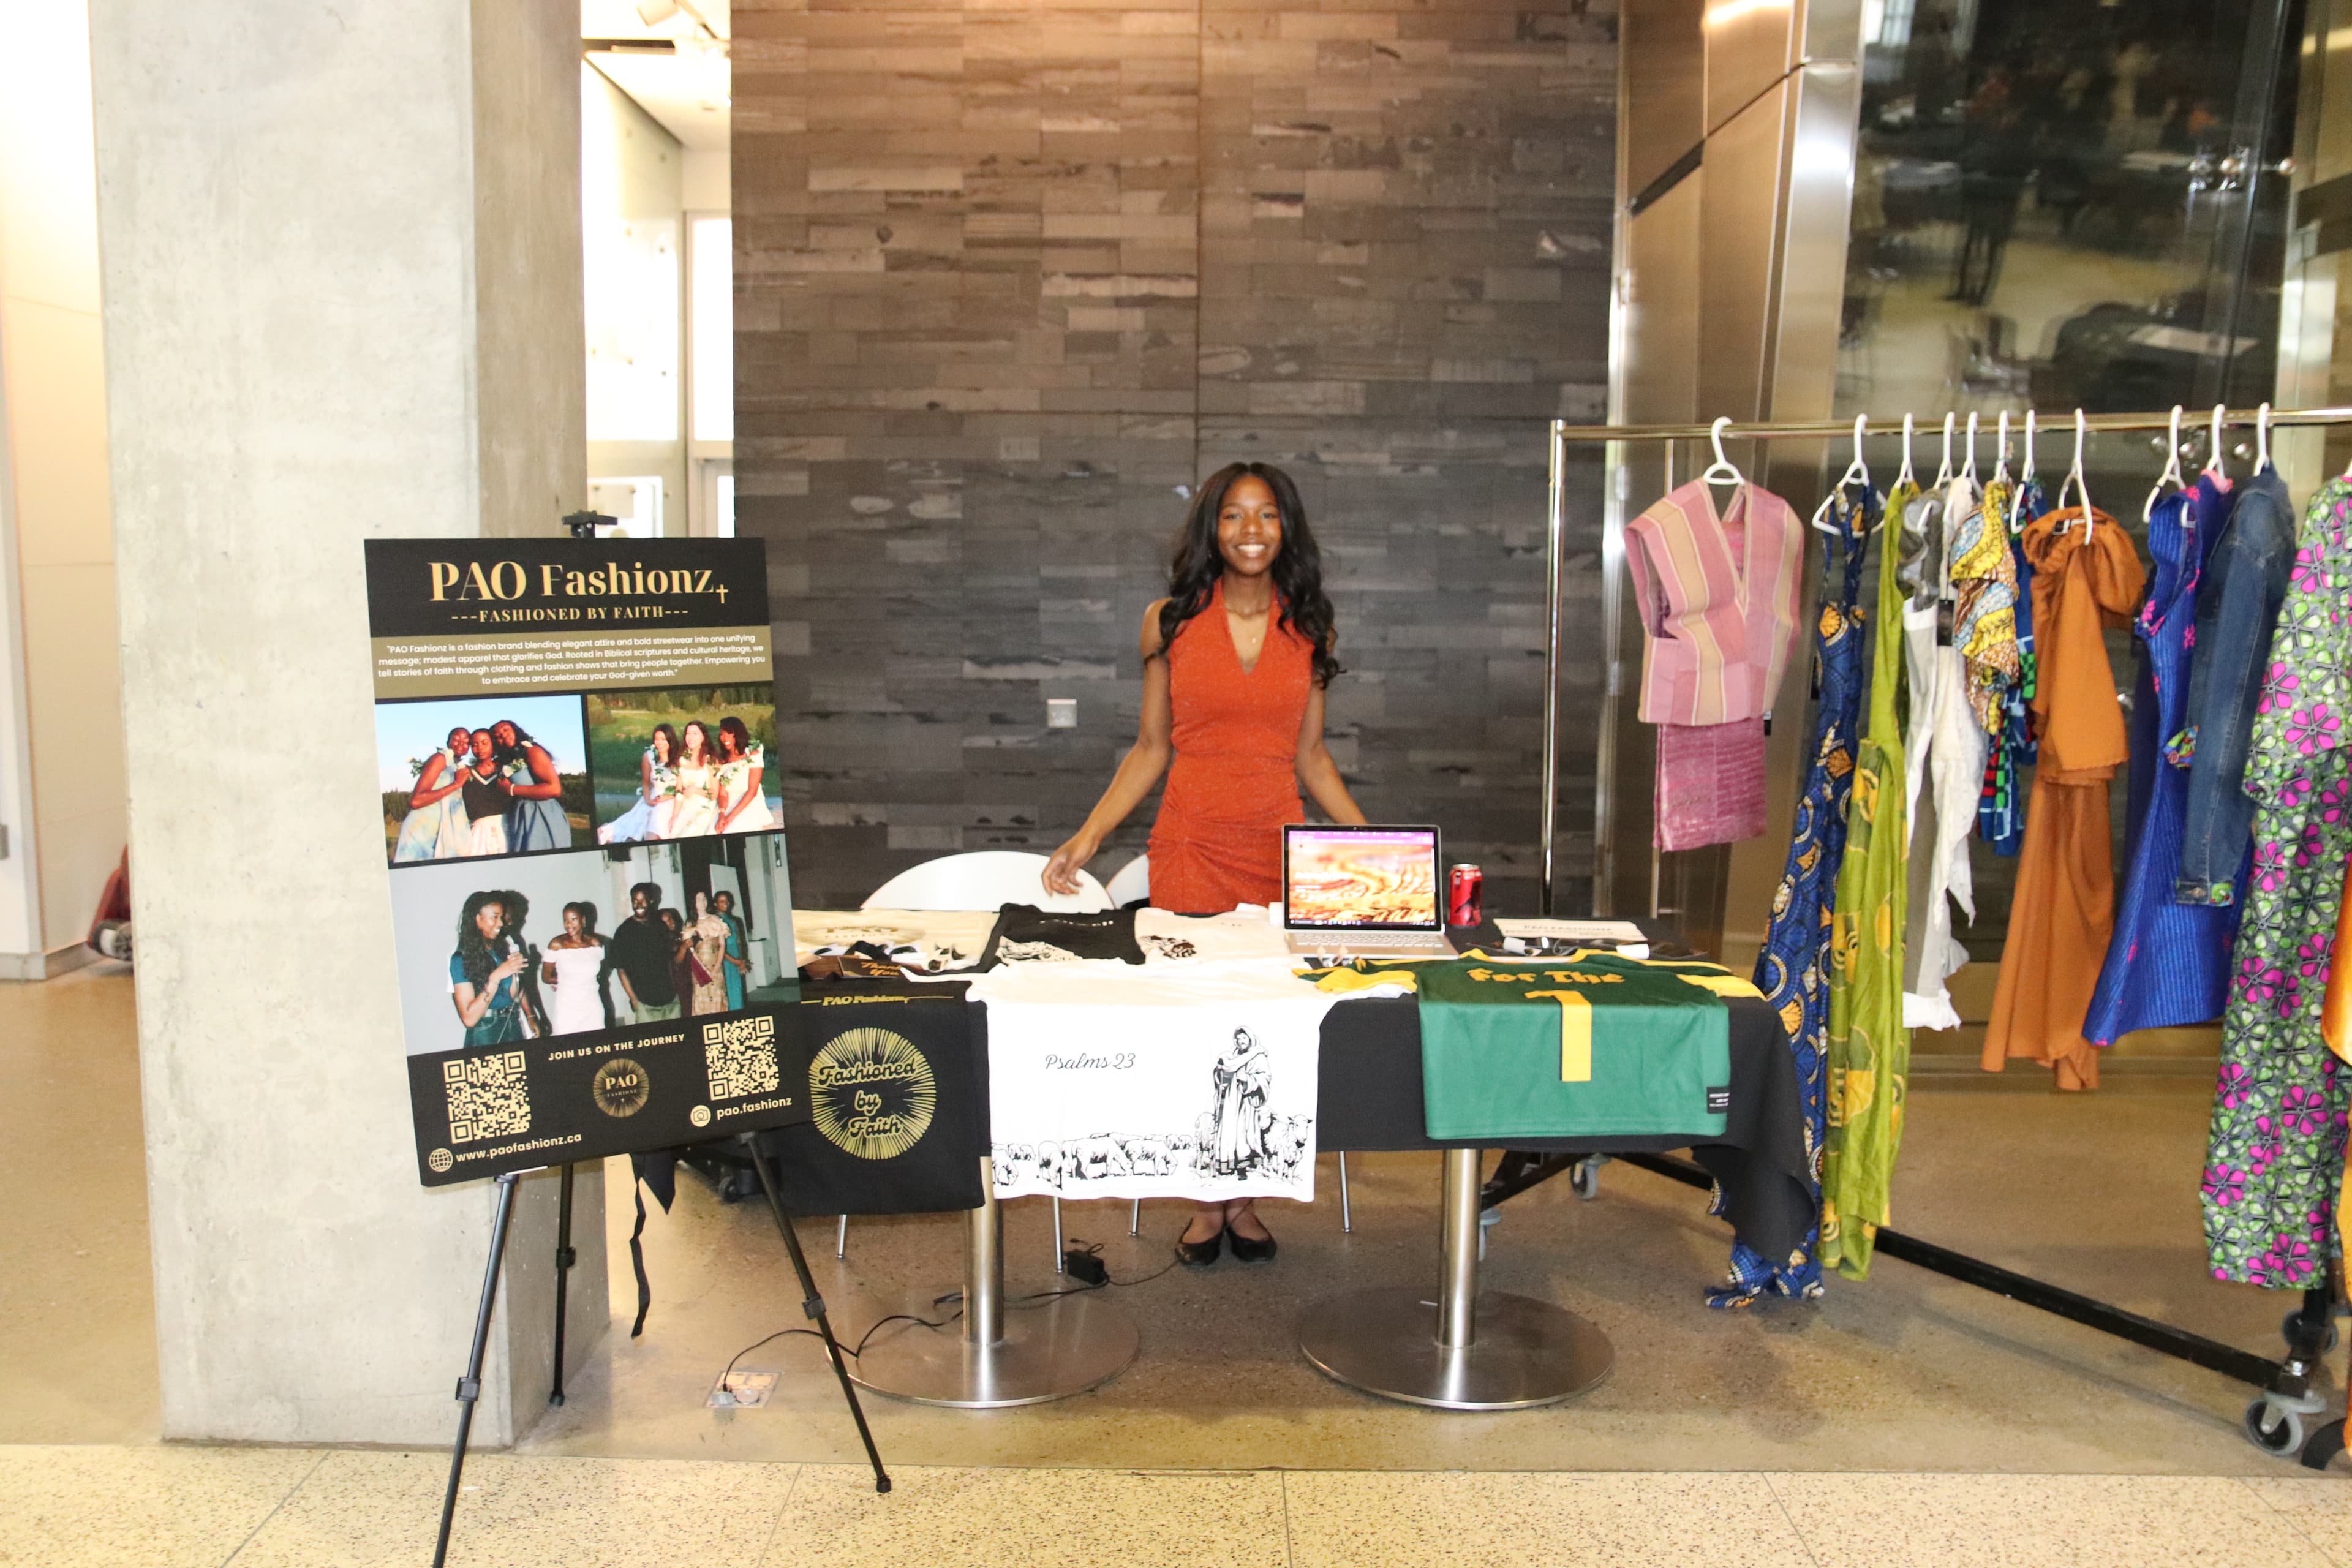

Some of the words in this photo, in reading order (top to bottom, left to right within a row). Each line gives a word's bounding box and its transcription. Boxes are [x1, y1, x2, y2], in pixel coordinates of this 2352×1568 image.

[428, 561, 526, 601] PAO
[540, 562, 714, 596] Fashionz
[587, 607, 607, 620] BY
[410, 644, 447, 652] Fashionz
[525, 641, 560, 650] blending
[562, 640, 593, 649] elegant
[726, 634, 755, 643] unifying
[379, 657, 421, 666] message;
[458, 654, 491, 664] apparel
[511, 652, 543, 662] glorifies
[719, 645, 752, 654] heritage,
[456, 665, 489, 676] through
[491, 665, 524, 674] clothing
[619, 660, 639, 669] bring
[641, 658, 668, 668] people
[669, 657, 703, 667] together.
[705, 656, 750, 665] Empowering
[492, 676, 530, 684] embrace
[549, 673, 588, 682] celebrate
[589, 673, 607, 682] your
[609, 671, 650, 680] God-given
[1544, 971, 1625, 984] The
[823, 996, 853, 1006] PAO
[549, 1049, 575, 1061] JOIN
[578, 1047, 592, 1057] US
[595, 1044, 611, 1054] ON
[614, 1041, 634, 1052] THE
[637, 1034, 685, 1048] JOURNEY
[1046, 1053, 1110, 1070] Psalms
[1112, 1053, 1136, 1069] 23
[605, 1074, 638, 1090] PAO
[818, 1057, 917, 1087] Fashioned
[717, 1098, 792, 1120] pao.fashionz
[854, 1090, 881, 1116] by
[848, 1115, 903, 1138] Faith
[456, 1134, 582, 1162] www.paofashionz.ca
